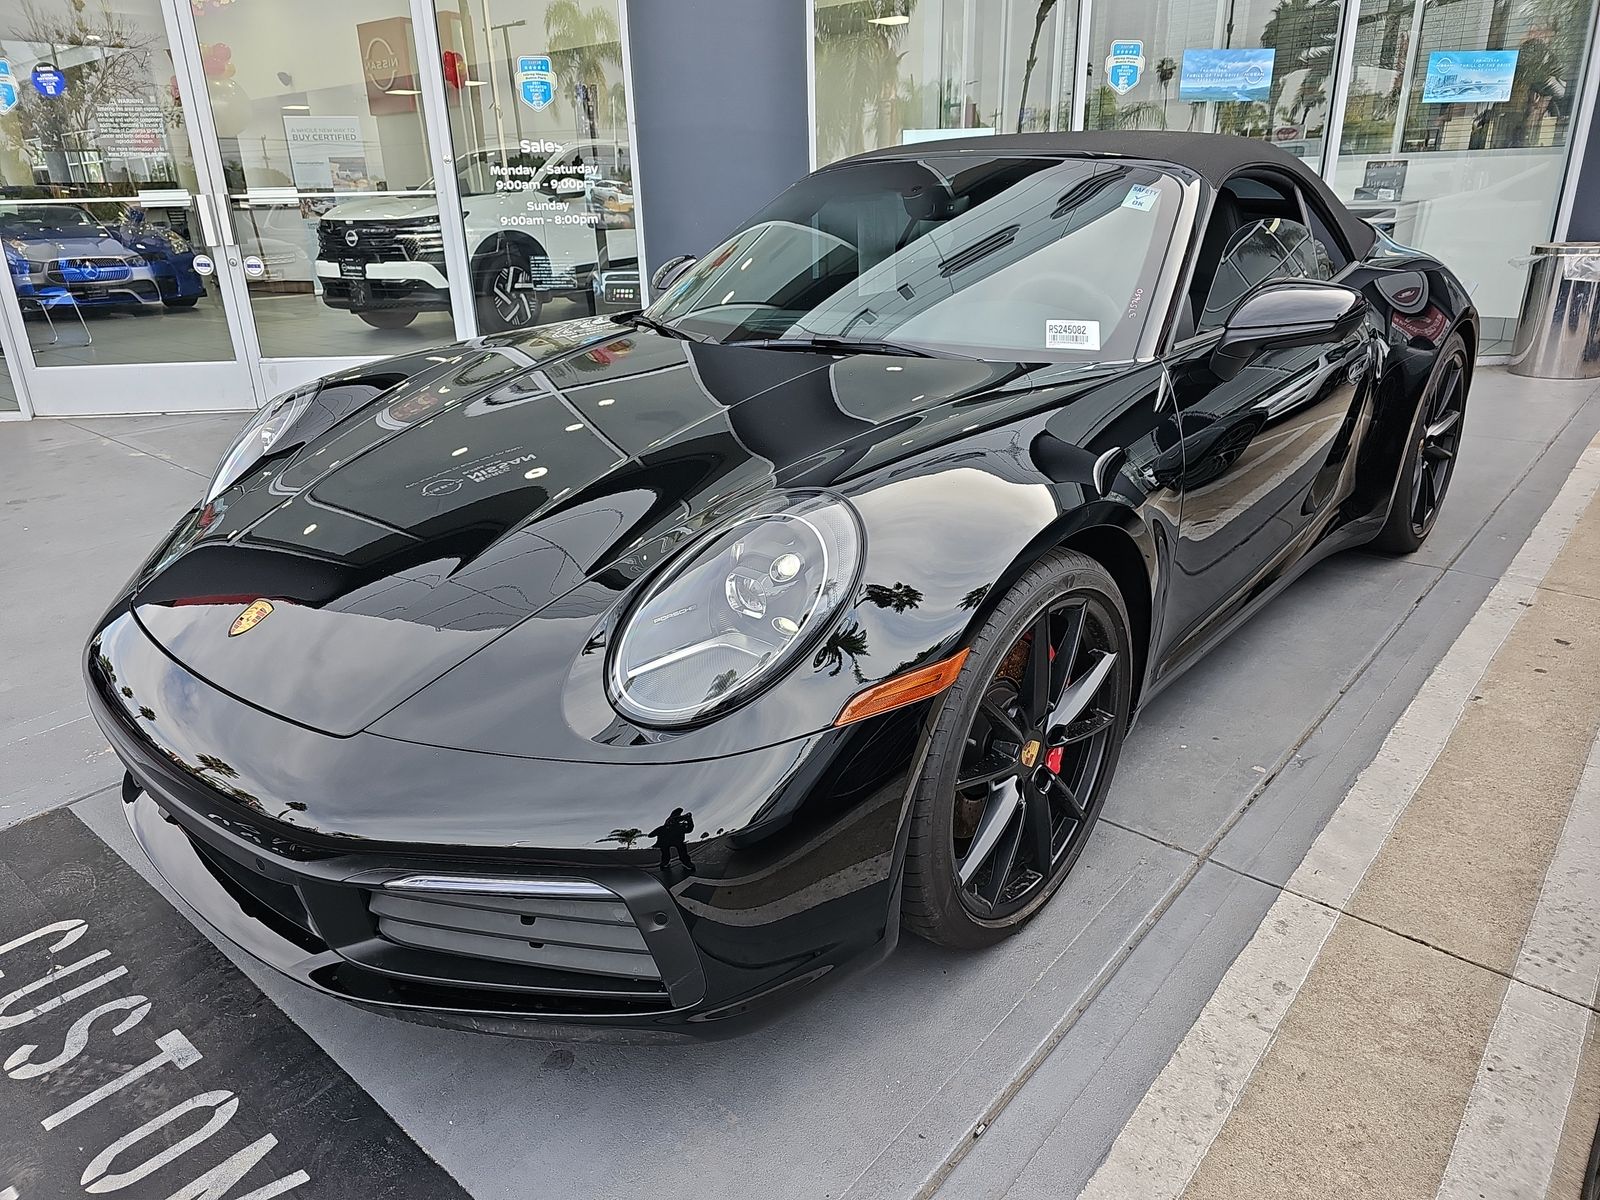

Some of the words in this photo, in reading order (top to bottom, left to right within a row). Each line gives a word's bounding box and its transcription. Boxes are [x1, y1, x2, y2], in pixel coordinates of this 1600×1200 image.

[520, 139, 563, 153] Sales
[490, 165, 536, 177] Monday
[546, 164, 599, 177] Saturday
[496, 180, 540, 190] 9:00am
[550, 179, 595, 190] 9:00pm
[1133, 186, 1158, 195] SAFETY
[527, 201, 569, 212] Sunday
[500, 216, 544, 225] 9:00am
[554, 215, 598, 226] 8:00pm
[1049, 325, 1086, 334] RS245082
